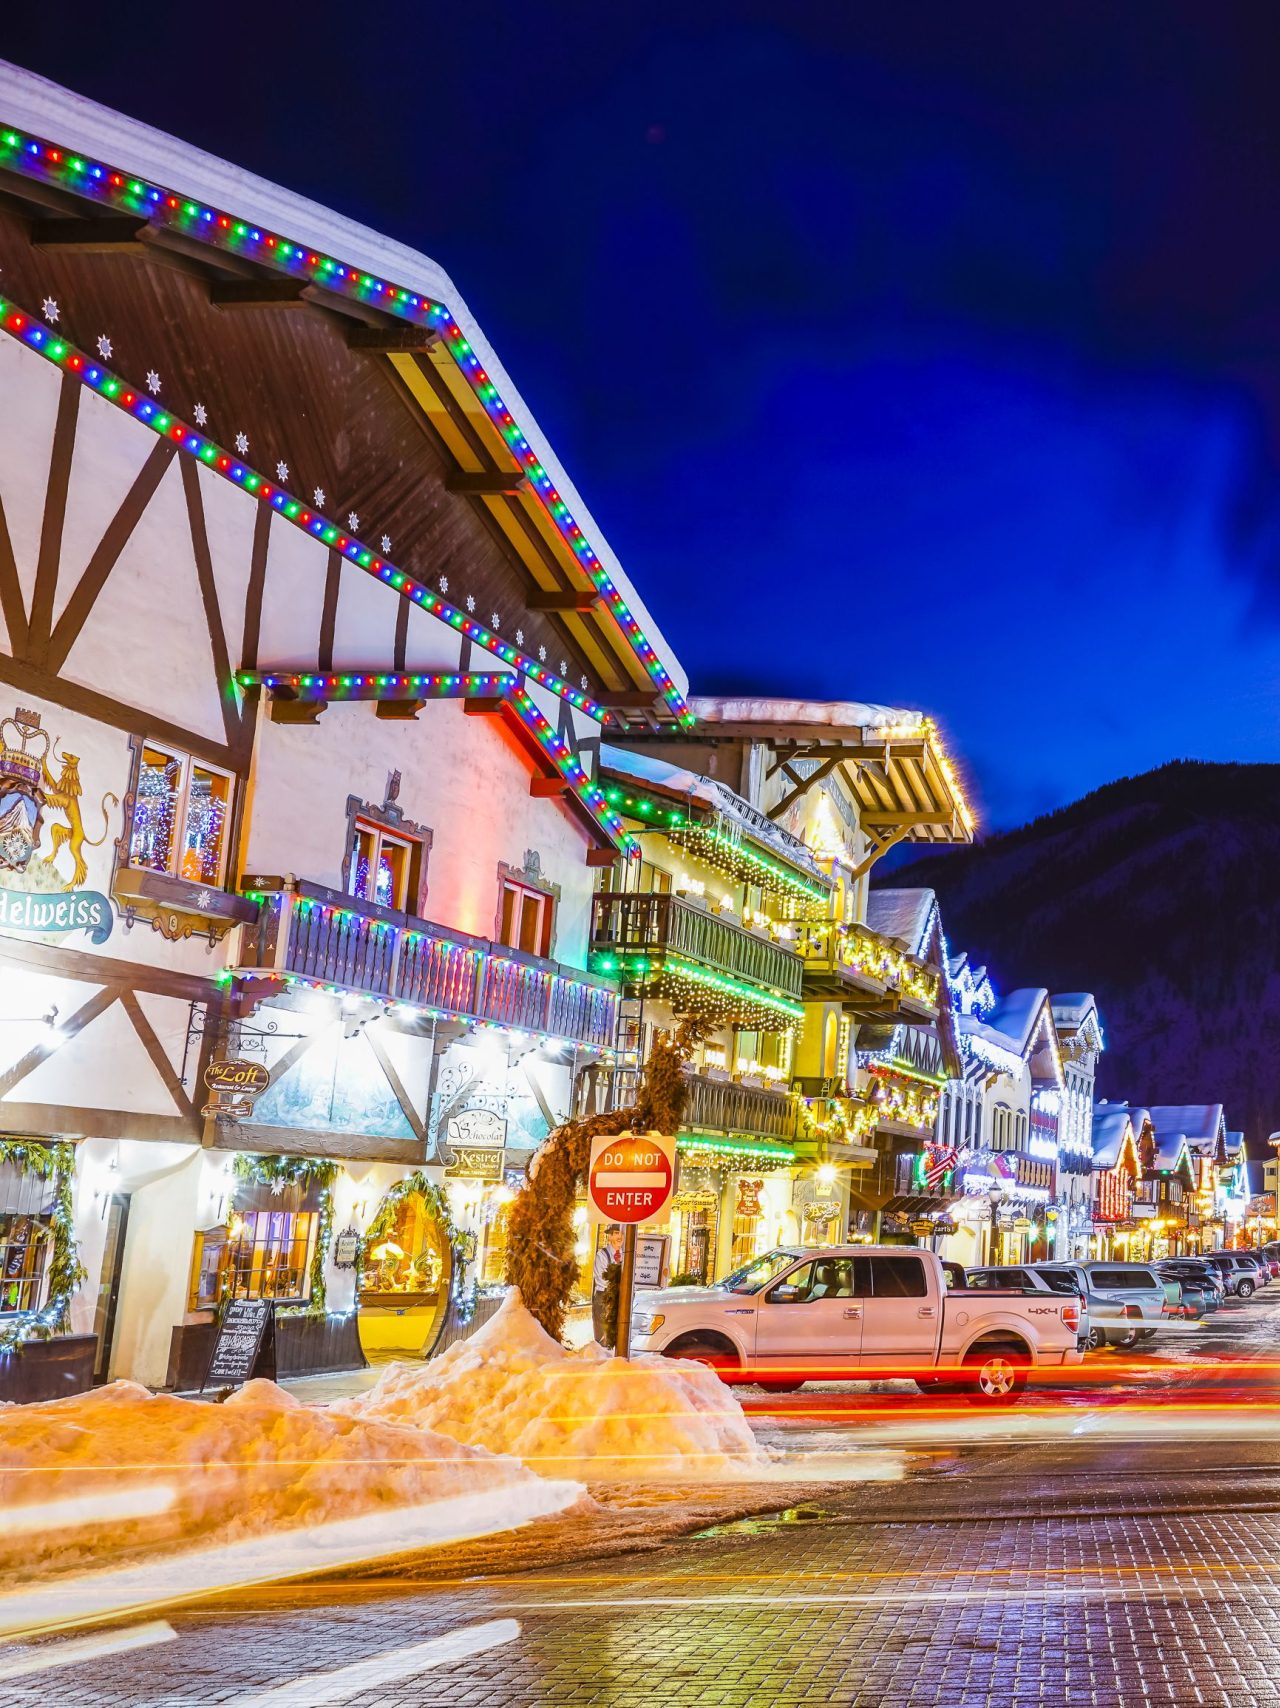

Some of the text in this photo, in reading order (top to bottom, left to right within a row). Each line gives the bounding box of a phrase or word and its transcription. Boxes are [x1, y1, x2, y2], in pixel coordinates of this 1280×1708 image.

[0, 892, 101, 927] delweiss
[208, 1066, 223, 1076] The
[215, 1066, 260, 1085] Loft
[459, 1150, 502, 1169] Kestrel
[604, 1152, 662, 1167] DO NOT
[606, 1192, 653, 1206] ENTER
